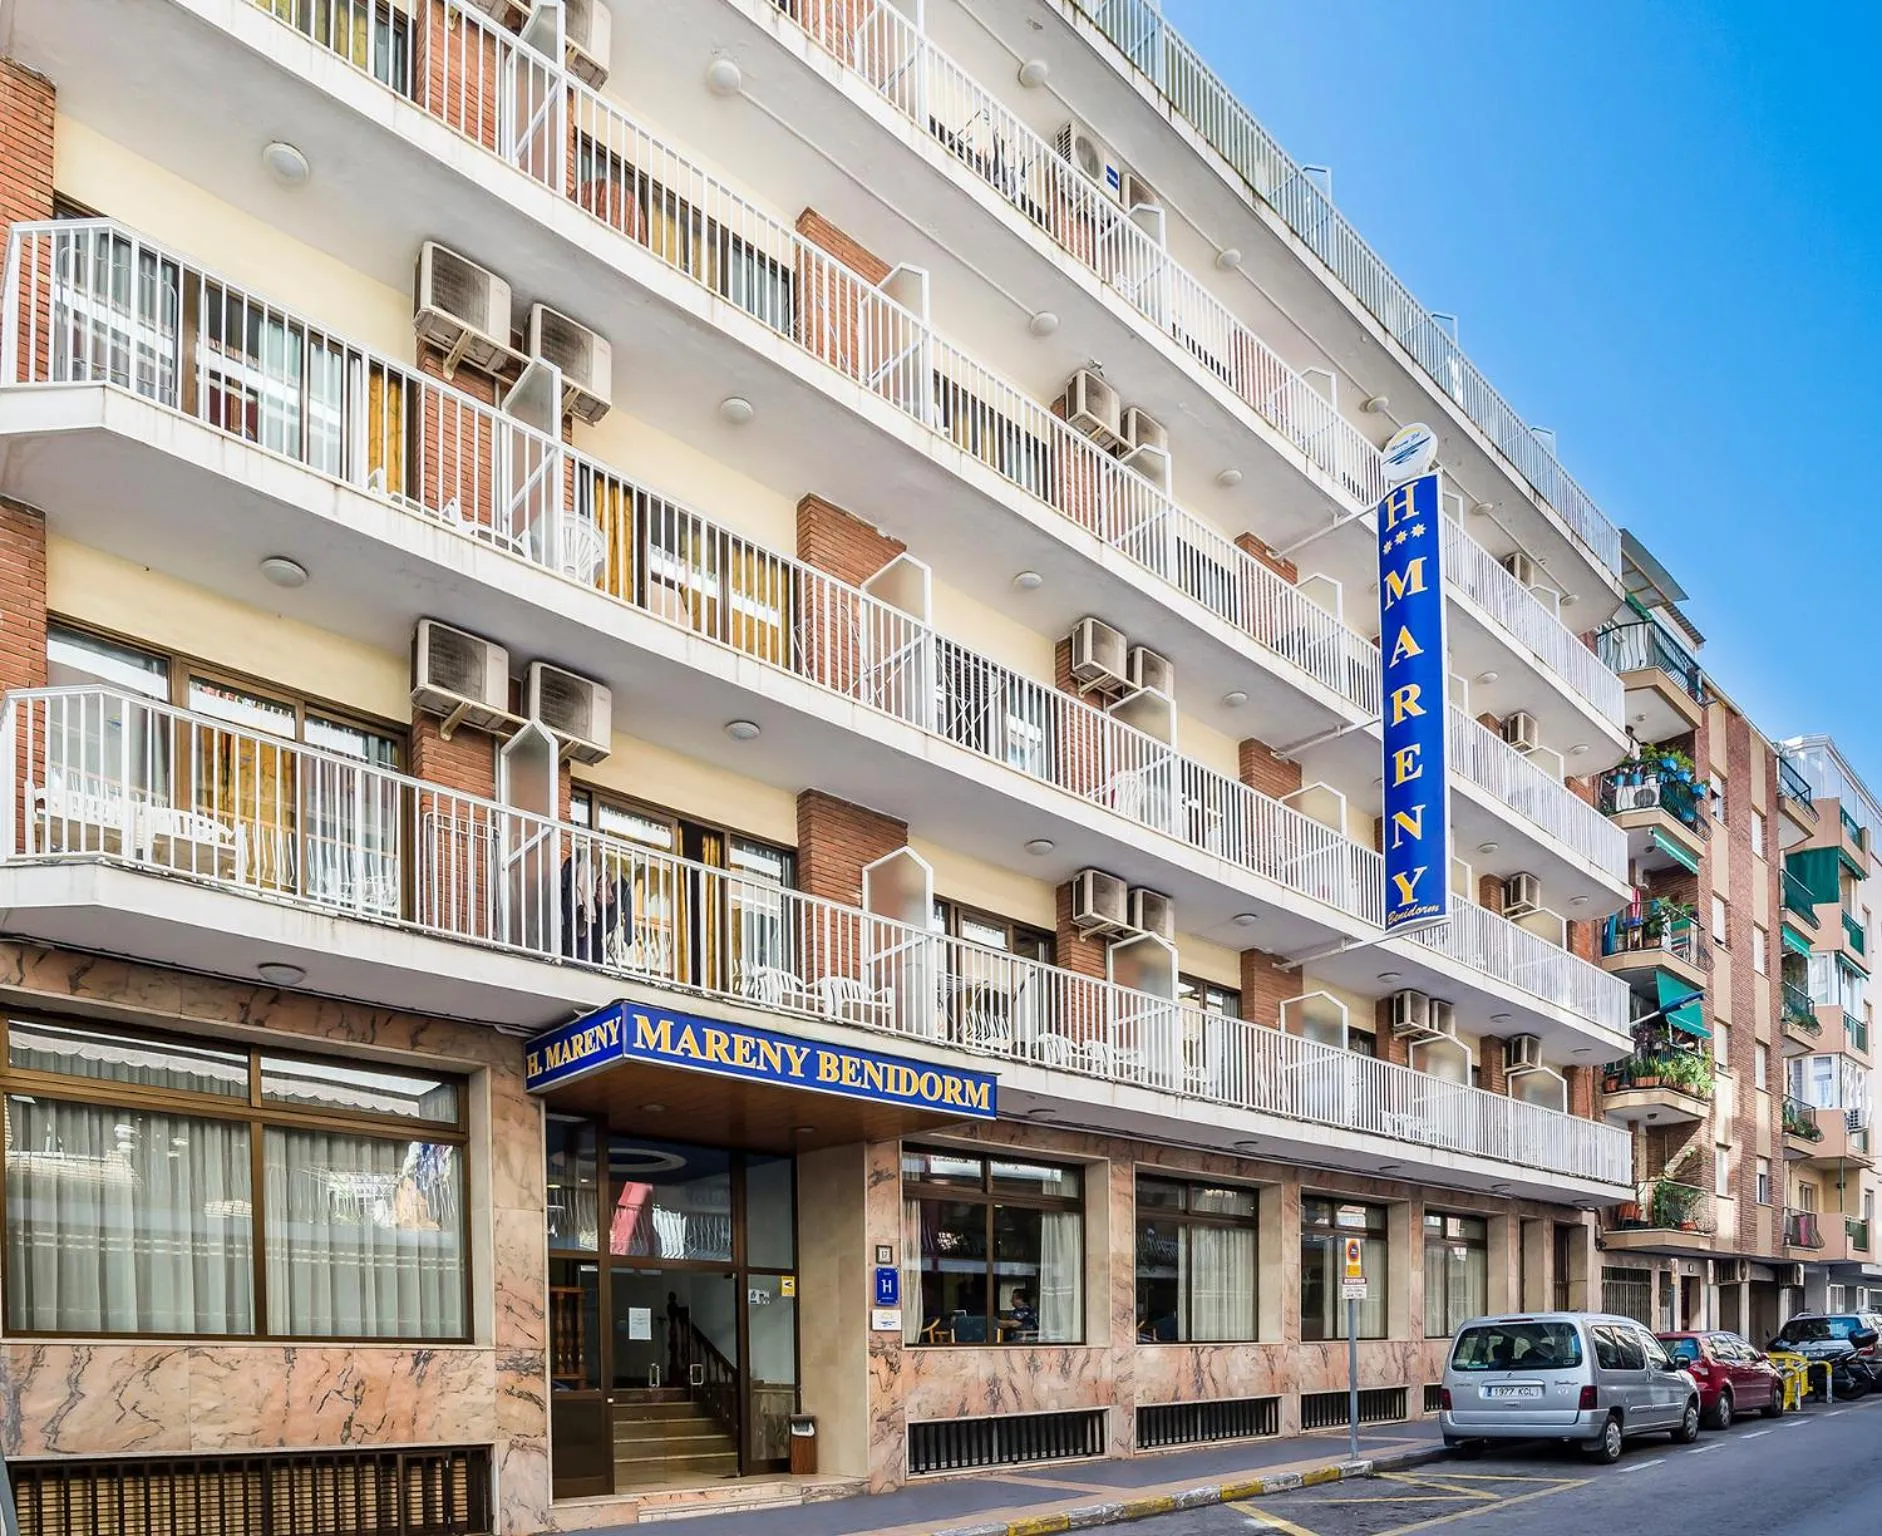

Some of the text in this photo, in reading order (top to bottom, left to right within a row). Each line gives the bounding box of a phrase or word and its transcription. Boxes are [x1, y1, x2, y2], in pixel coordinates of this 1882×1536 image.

[1385, 482, 1420, 532] H
[1384, 556, 1428, 906] MARENY
[1388, 904, 1440, 925] Benidorm
[527, 1016, 622, 1079] H. MARENY
[633, 1014, 992, 1110] MARENY BENIDORM
[881, 1279, 892, 1294] H
